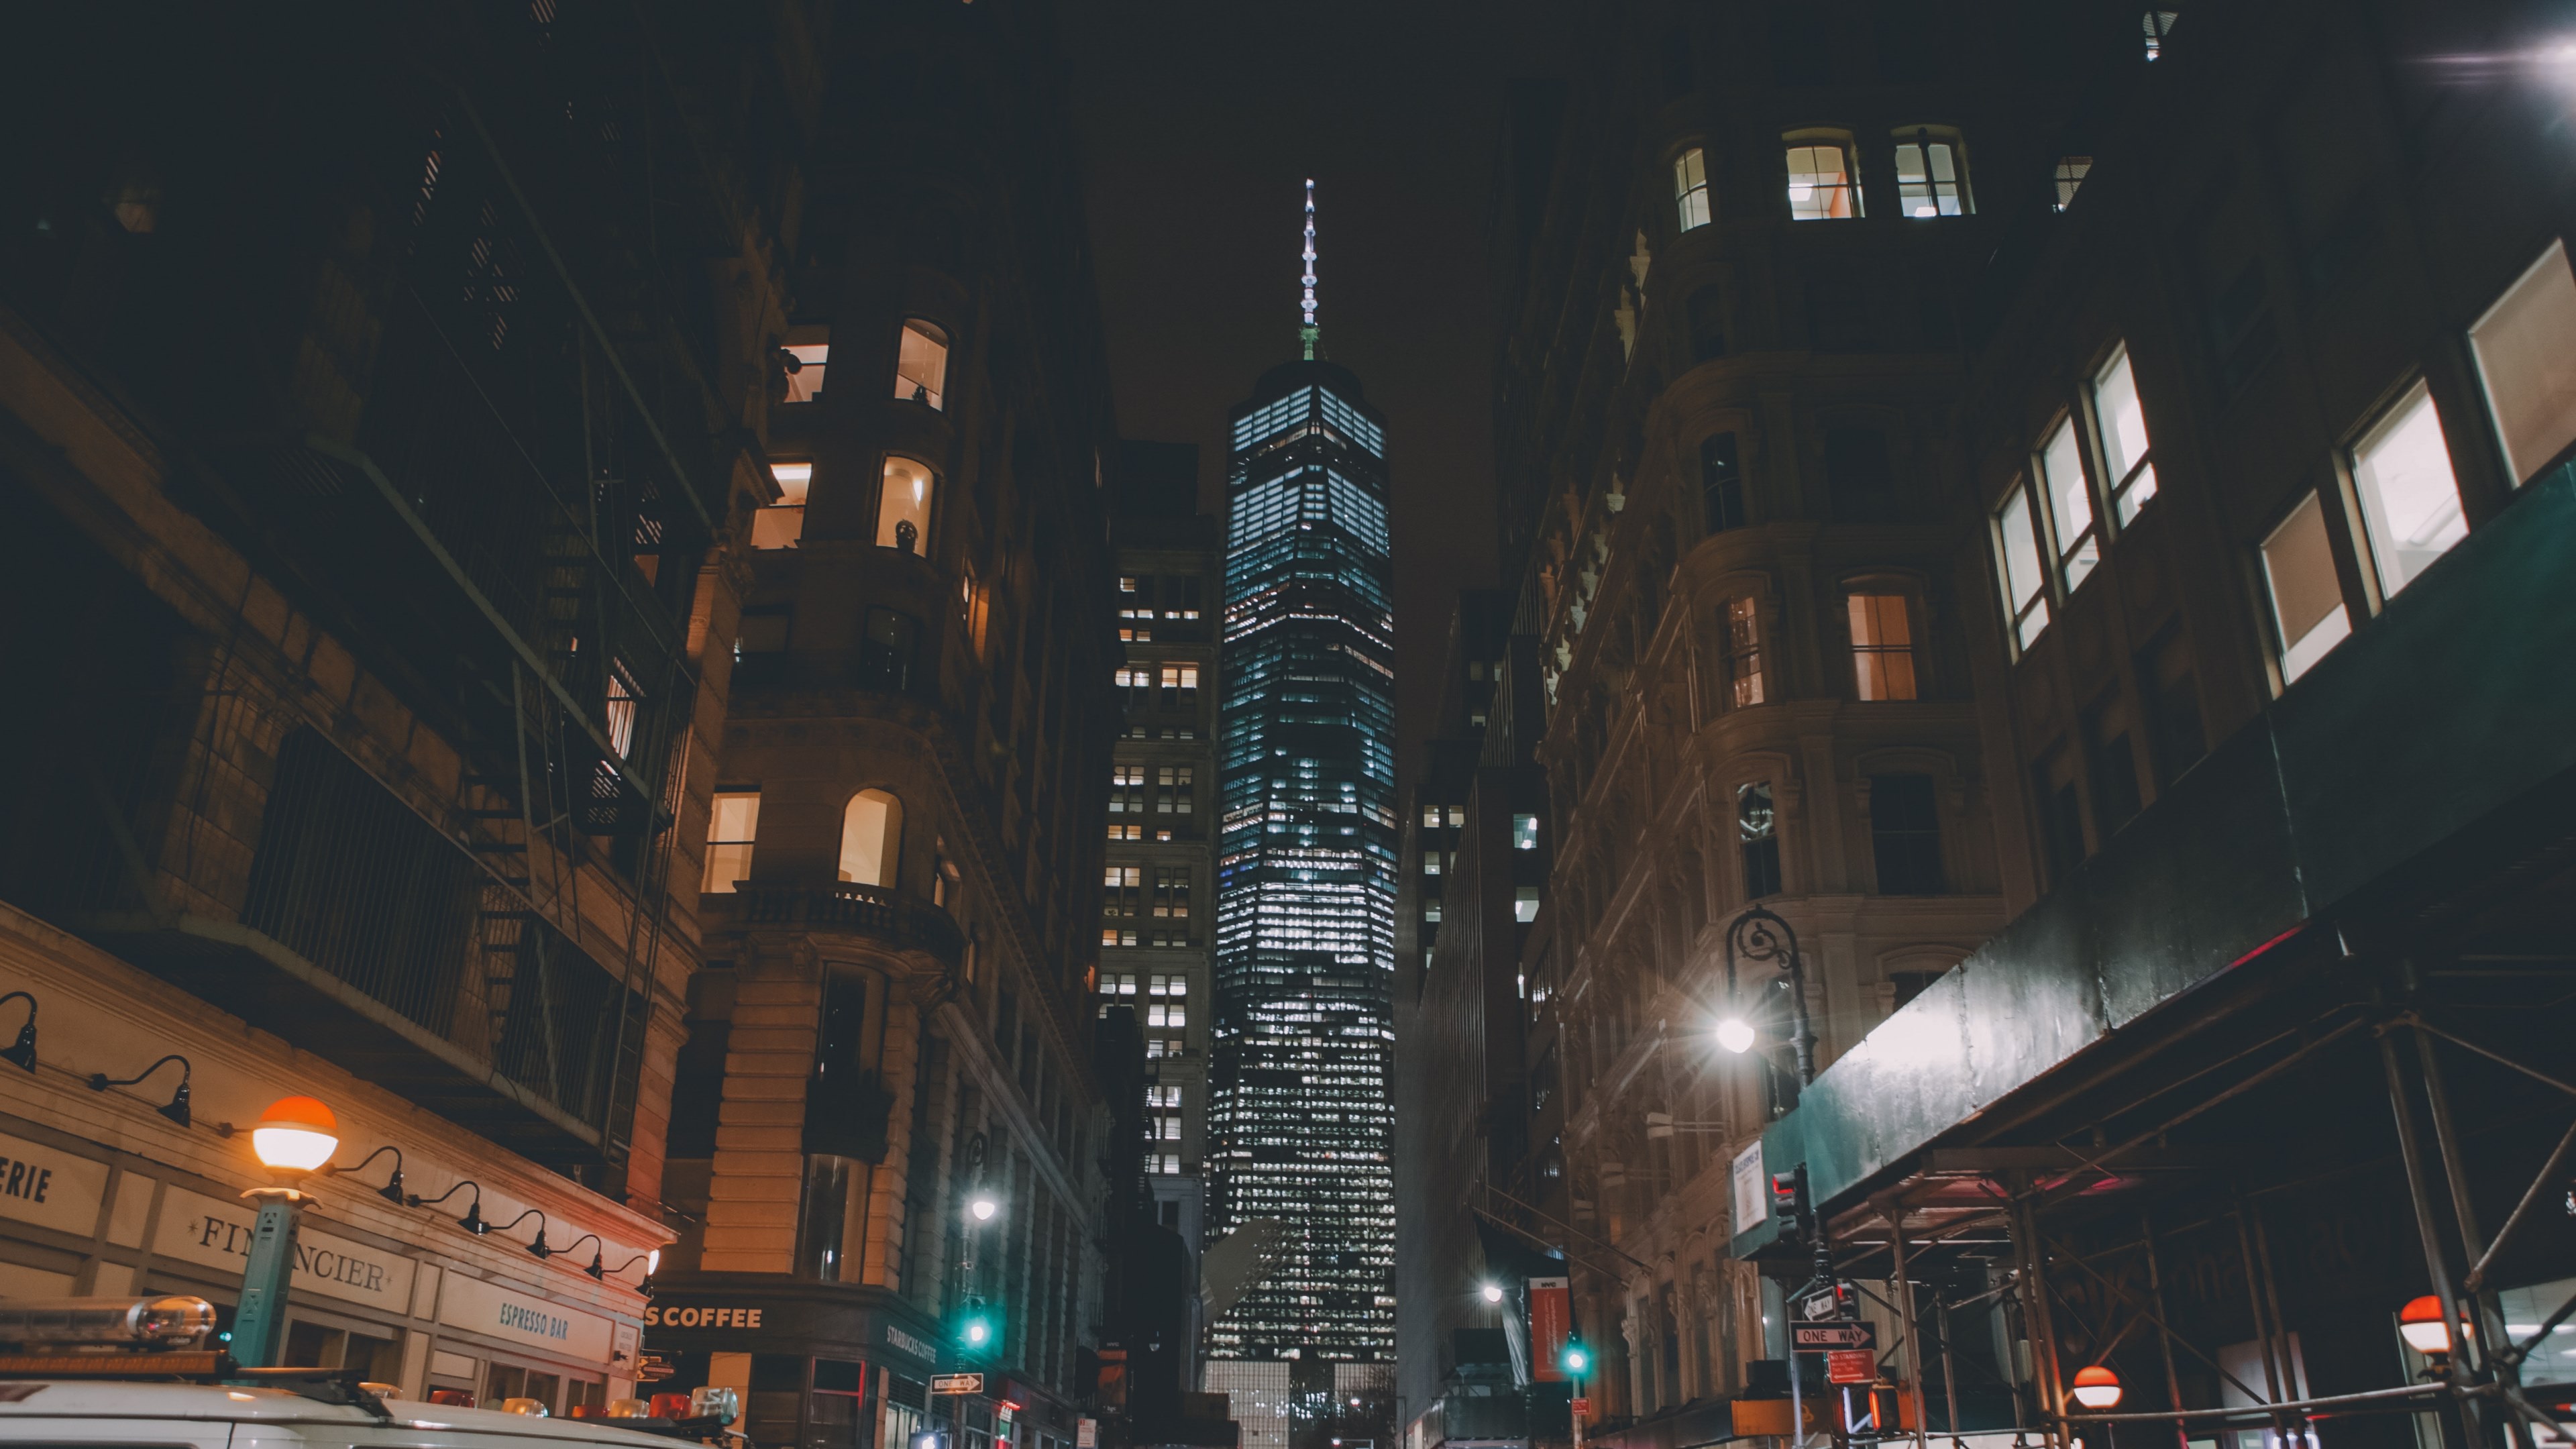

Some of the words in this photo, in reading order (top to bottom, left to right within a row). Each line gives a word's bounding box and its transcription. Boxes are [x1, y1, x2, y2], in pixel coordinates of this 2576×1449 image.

[500, 1302, 547, 1334] ESPRESSO
[549, 1317, 569, 1340] BAR
[663, 1307, 763, 1328] COFFEE
[887, 1324, 918, 1356] STARBUCKS
[918, 1340, 937, 1364] COFFEE
[1803, 1330, 1828, 1342] ONE
[1837, 1330, 1863, 1342] WAY
[1839, 1352, 1866, 1360] STANDING
